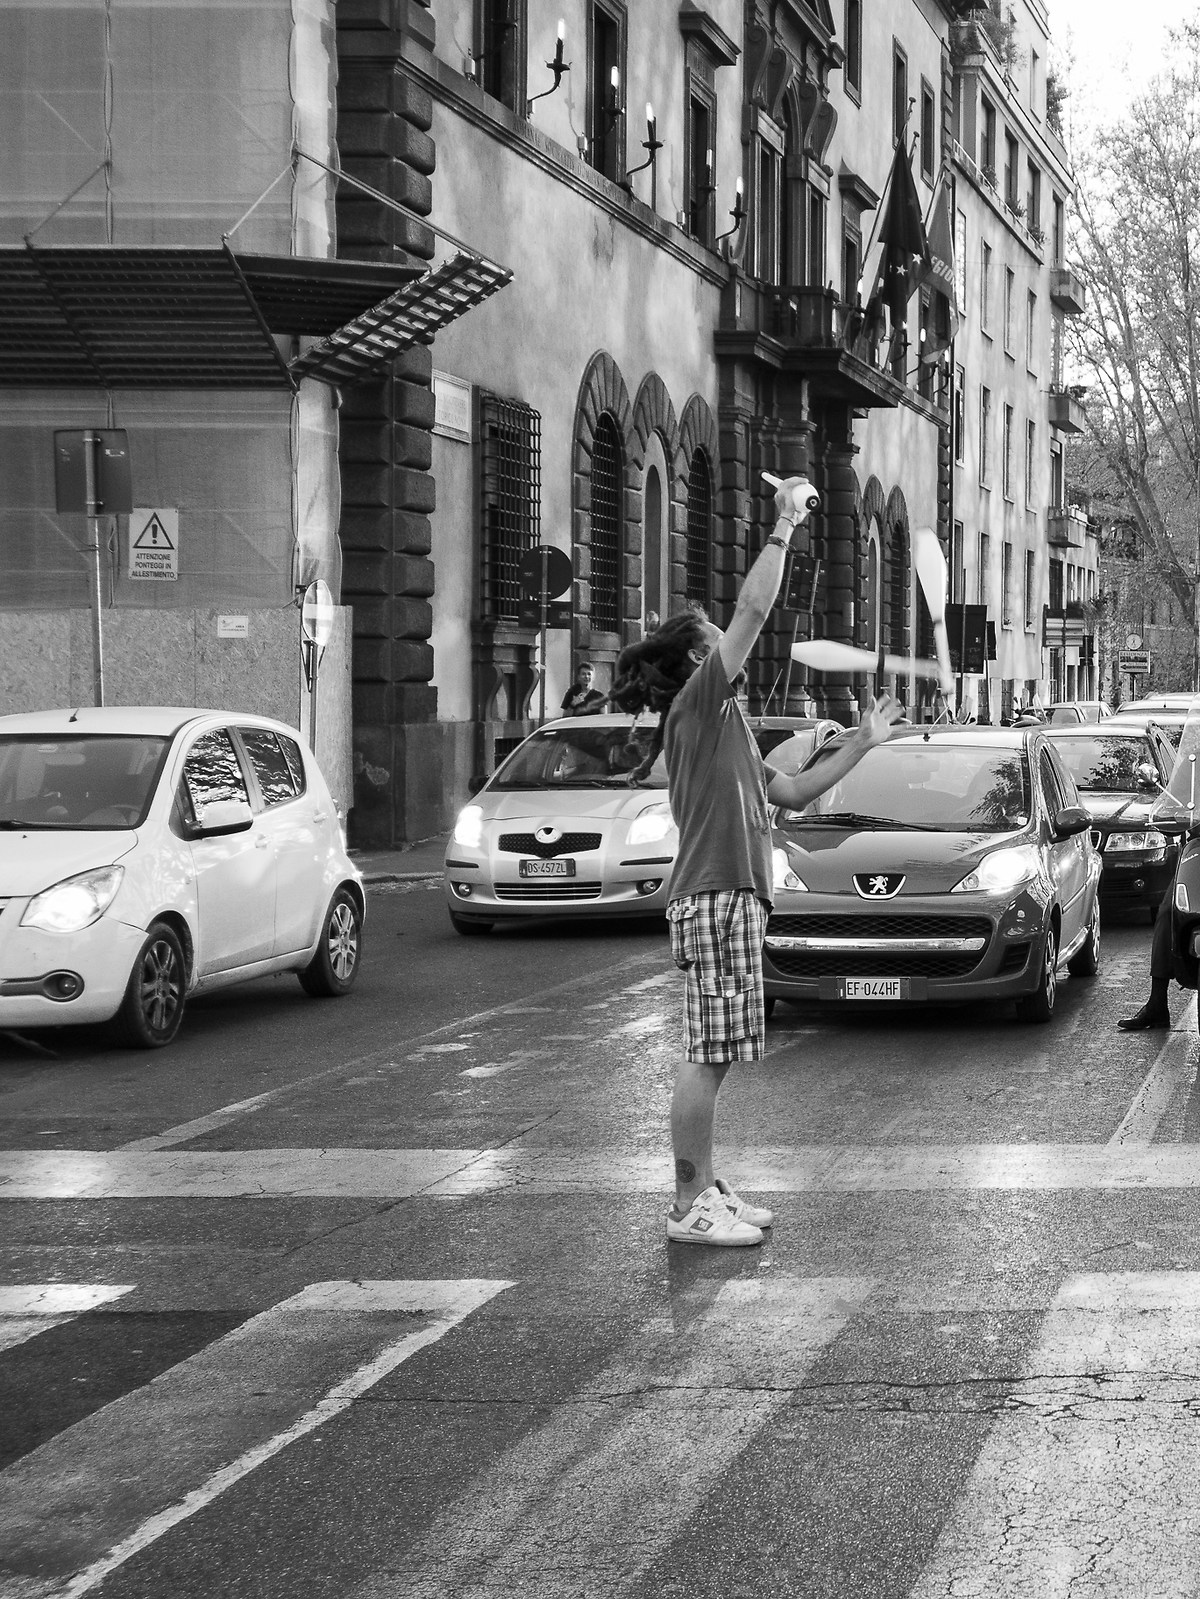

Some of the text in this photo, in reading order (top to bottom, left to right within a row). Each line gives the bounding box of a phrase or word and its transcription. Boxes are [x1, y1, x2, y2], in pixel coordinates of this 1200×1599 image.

[136, 552, 171, 561] ATTENZIONE
[135, 561, 172, 570] PONTEGGI IN
[132, 570, 175, 578] ALLESTIMENTO
